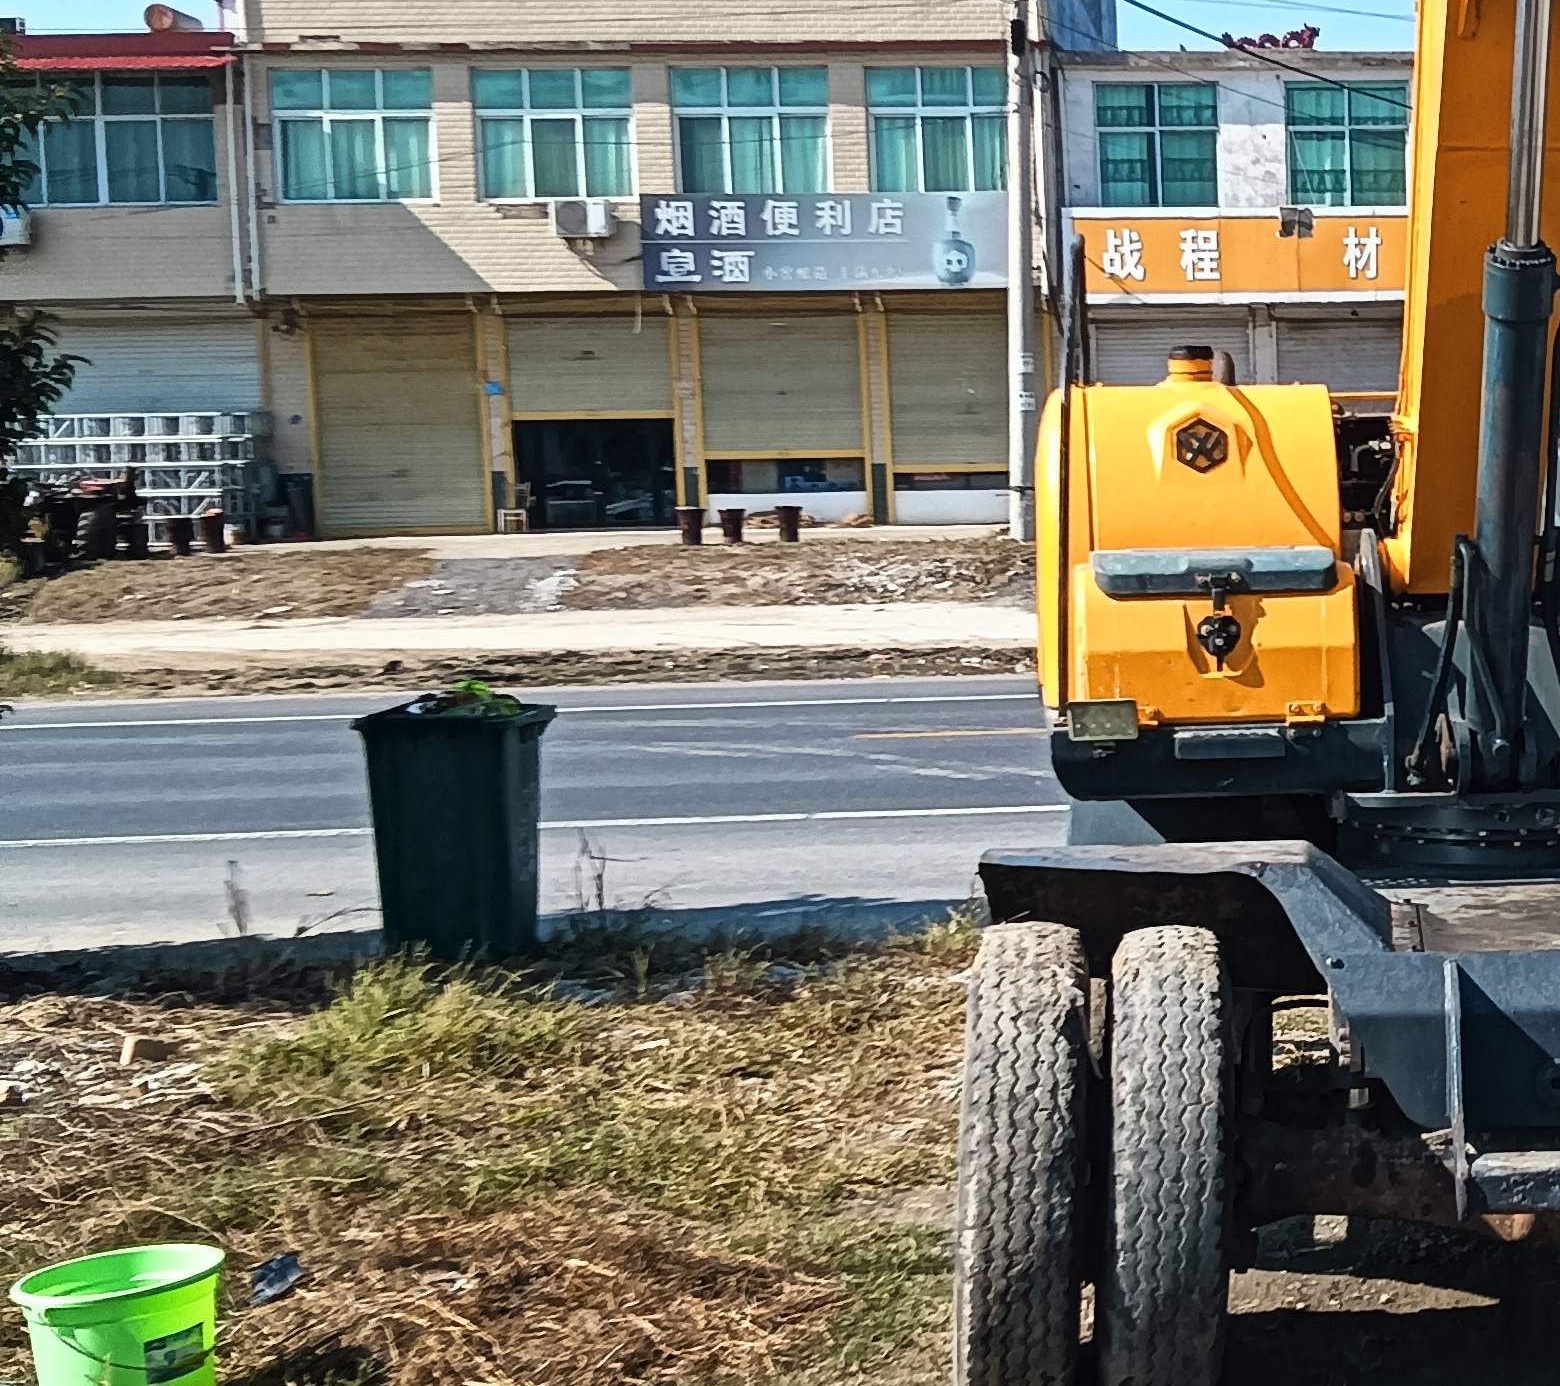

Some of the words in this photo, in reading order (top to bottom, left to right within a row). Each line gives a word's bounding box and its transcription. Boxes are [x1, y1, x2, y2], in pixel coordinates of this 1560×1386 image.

[654, 199, 904, 237] 烟酒便利店
[654, 248, 757, 283] 宣酒
